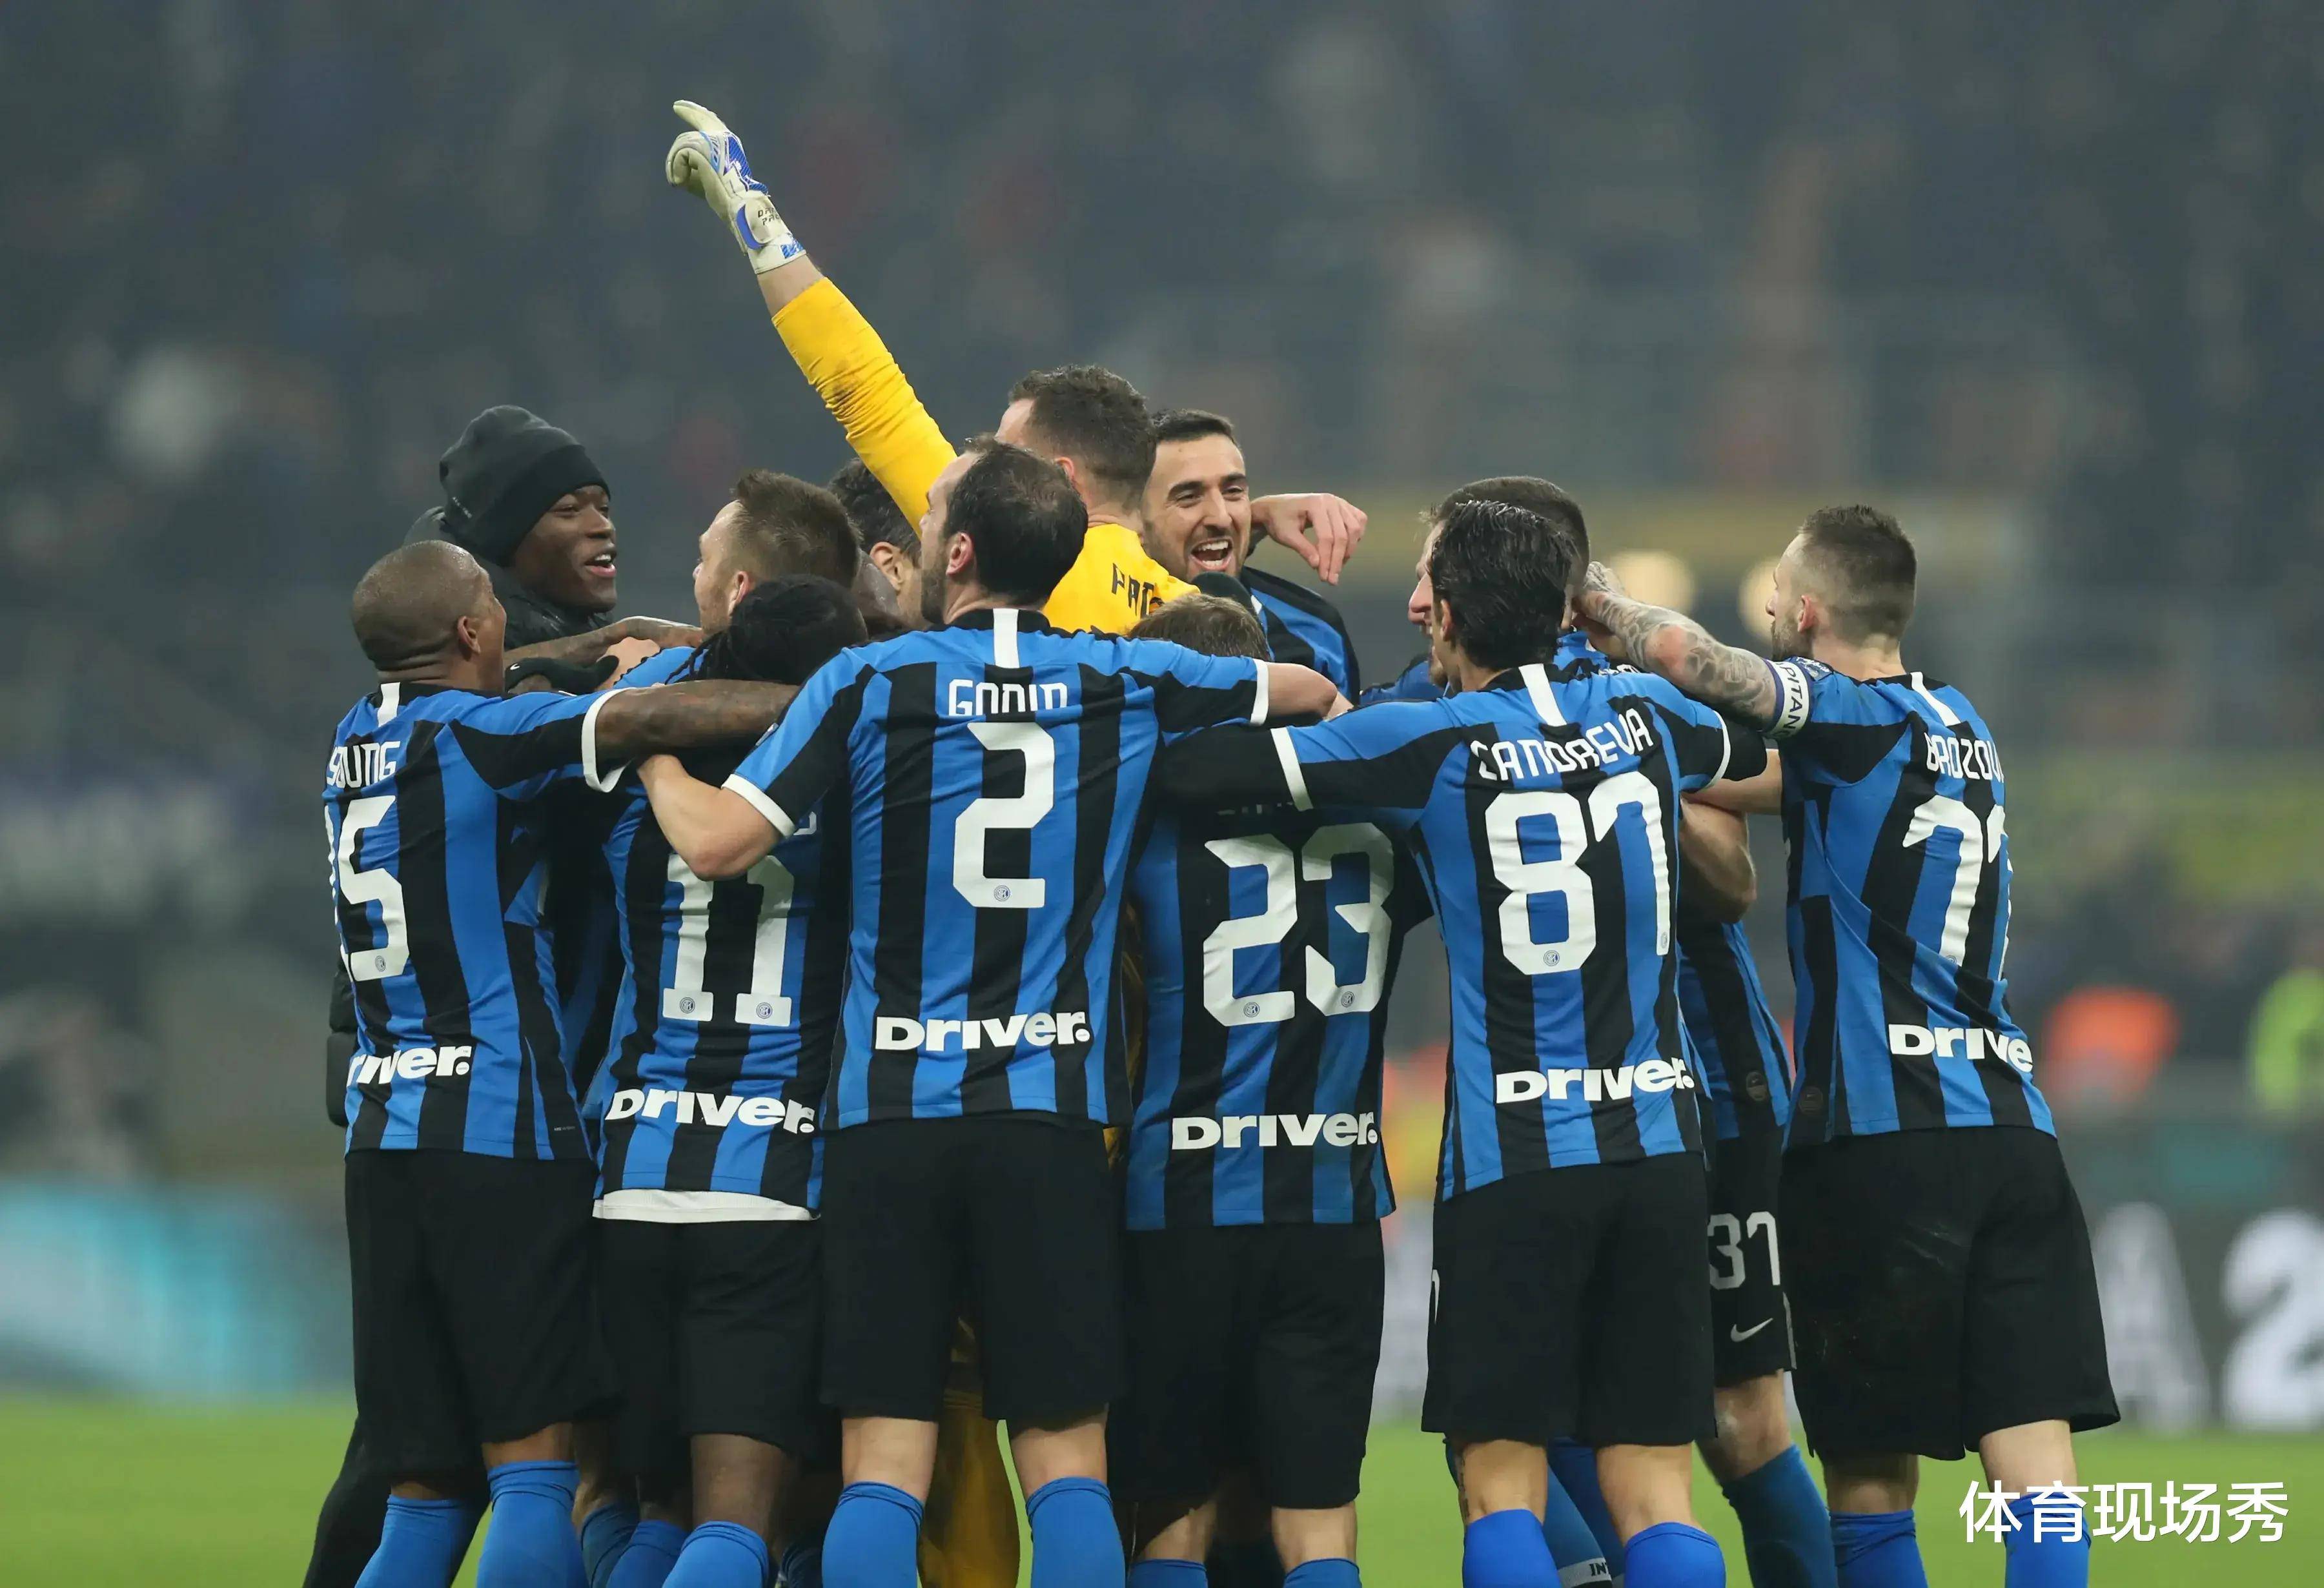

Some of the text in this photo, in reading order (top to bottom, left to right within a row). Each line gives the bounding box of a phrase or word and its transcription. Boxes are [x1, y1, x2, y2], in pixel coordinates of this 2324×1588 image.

[1470, 707, 1654, 781] CANDREVA
[1771, 662, 1803, 736] PITAN
[1924, 732, 2004, 780] BROZOV
[953, 722, 1055, 908] 2
[324, 795, 410, 982] 5
[662, 853, 795, 1026] 11
[1203, 822, 1394, 1026] 23
[1888, 1024, 2033, 1073] Drive
